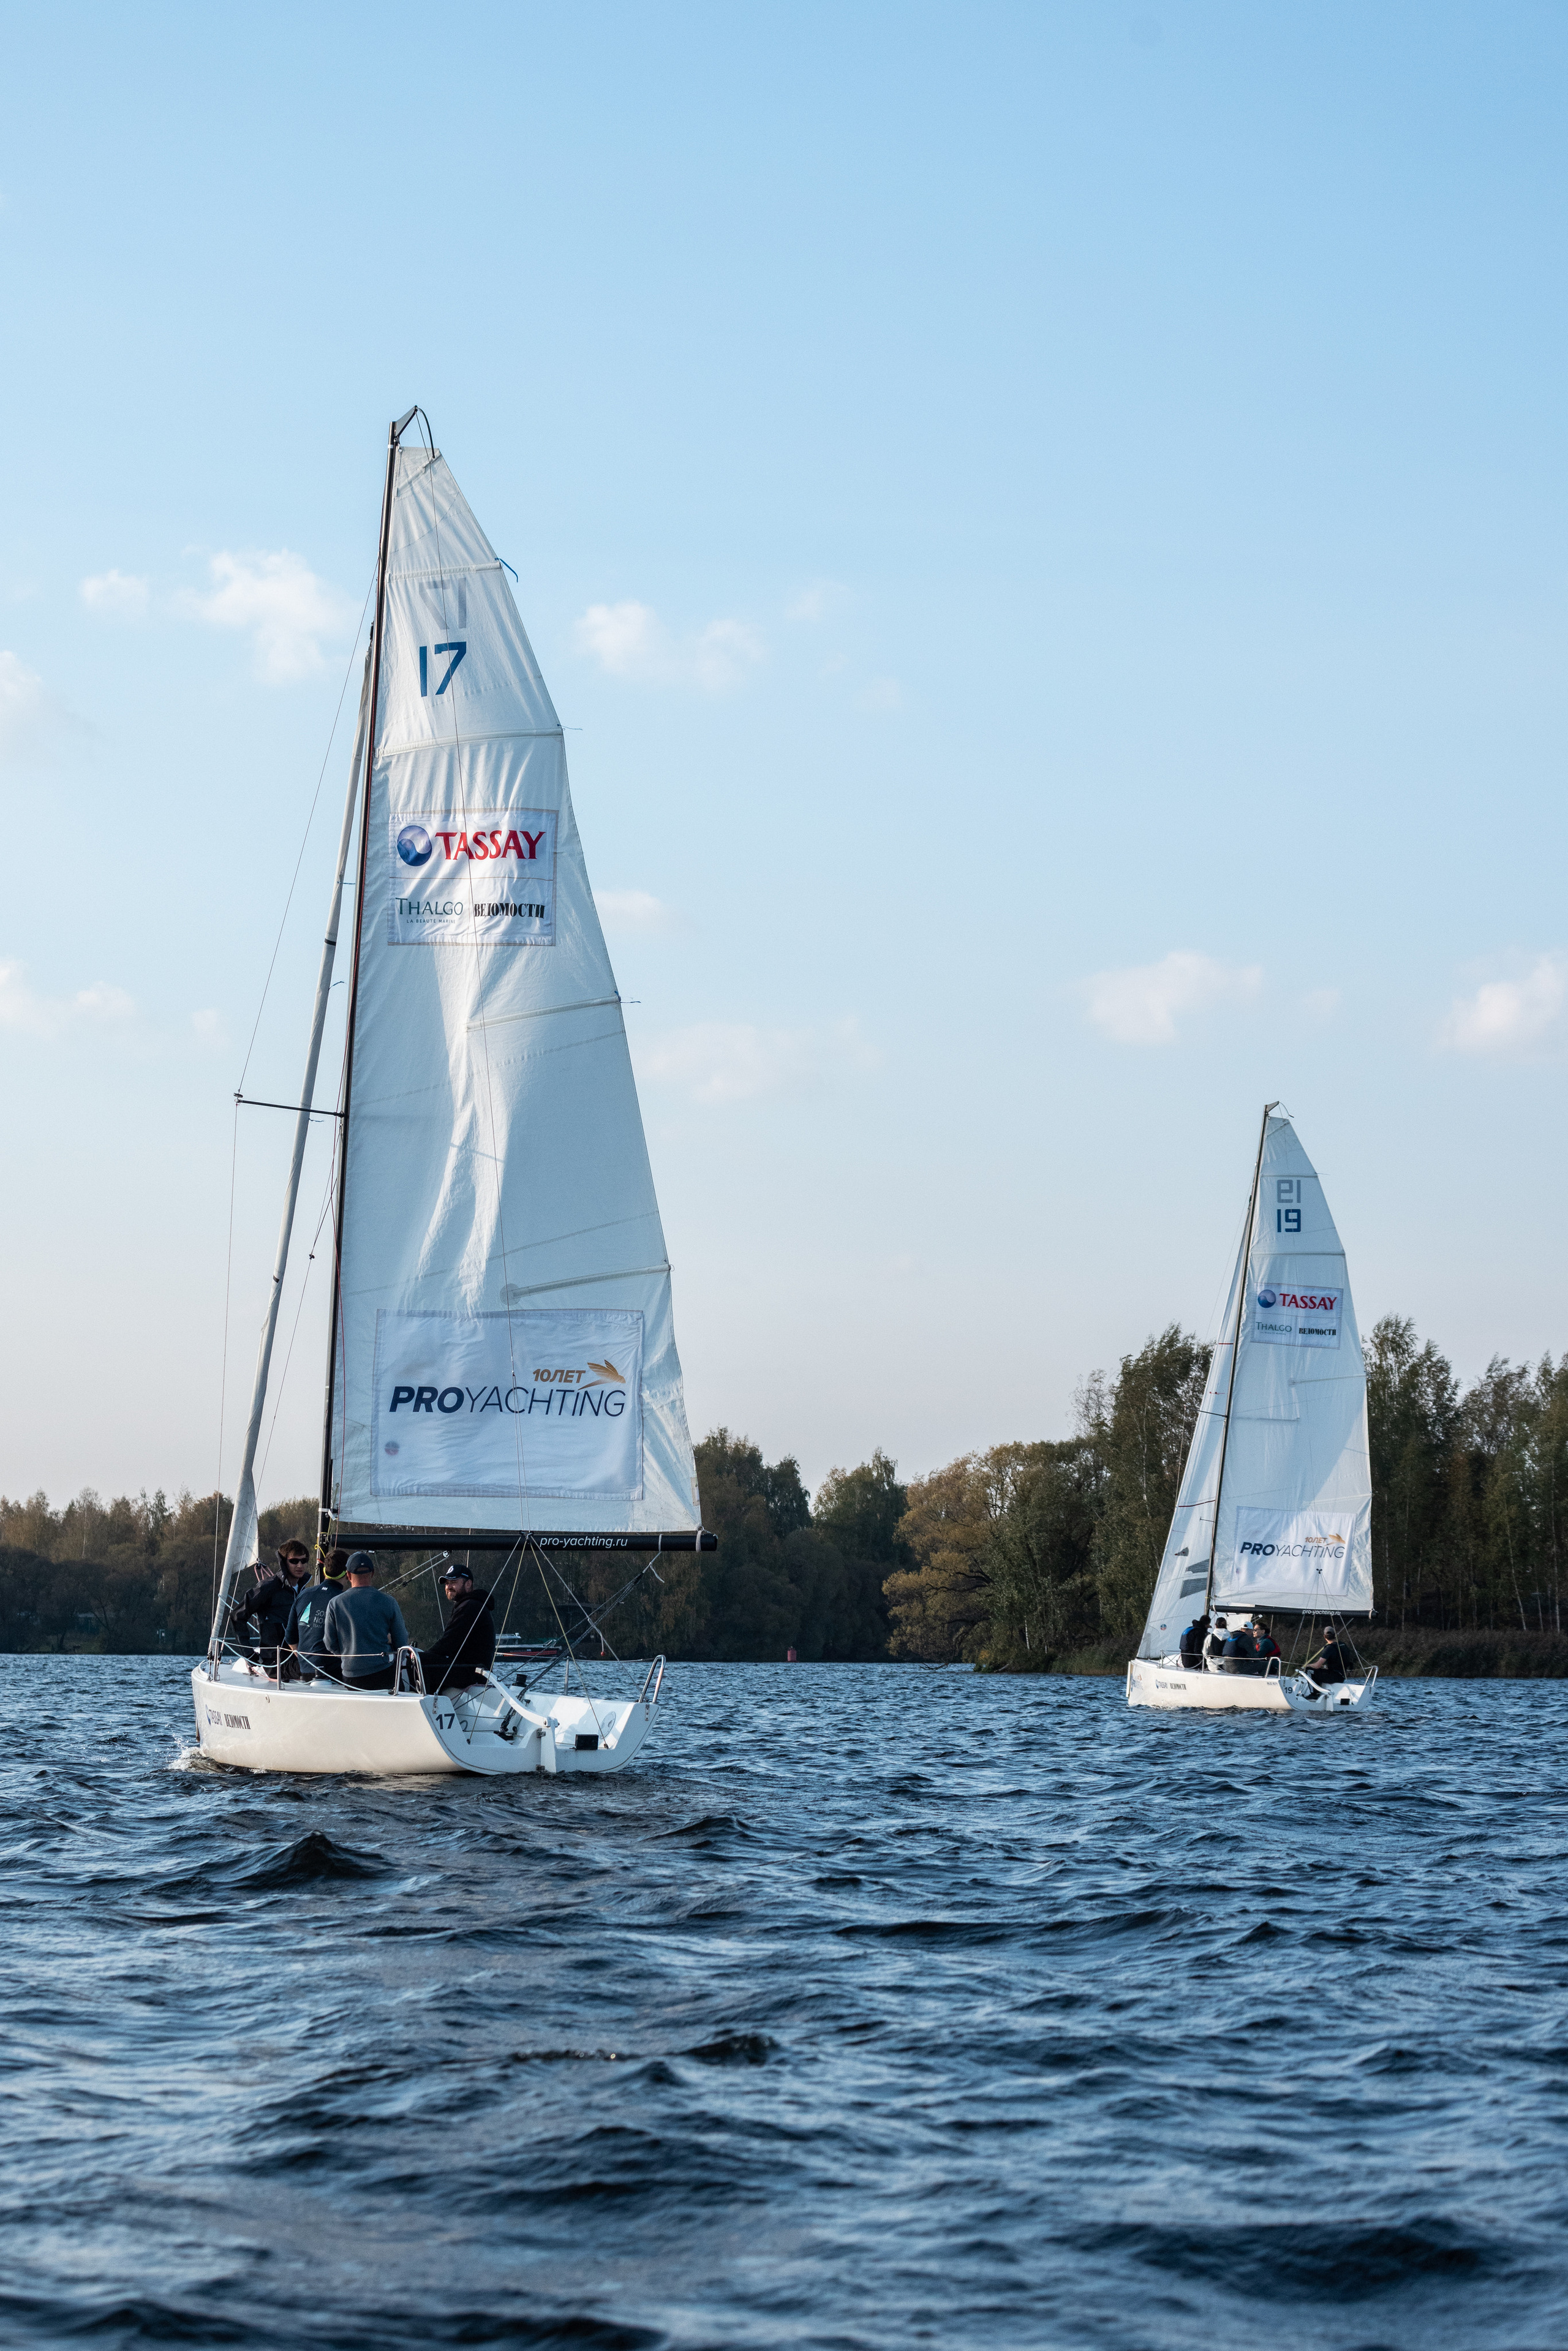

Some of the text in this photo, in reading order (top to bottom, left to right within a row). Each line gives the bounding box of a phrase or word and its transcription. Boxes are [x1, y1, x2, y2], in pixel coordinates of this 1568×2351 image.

[420, 641, 467, 697] 17
[435, 830, 546, 860] TASSAY
[474, 903, 545, 919] ВЕДОМОСТИ
[1277, 1209, 1301, 1232] 19
[1279, 1293, 1337, 1310] TASSAY
[1298, 1327, 1336, 1336] ВЕДОМОСТИ
[389, 1386, 626, 1417] PROYACHTING
[540, 1536, 628, 1549] pro-yachting.ru
[1240, 1542, 1345, 1558] PROYACHTING
[435, 1713, 455, 1729] 17
